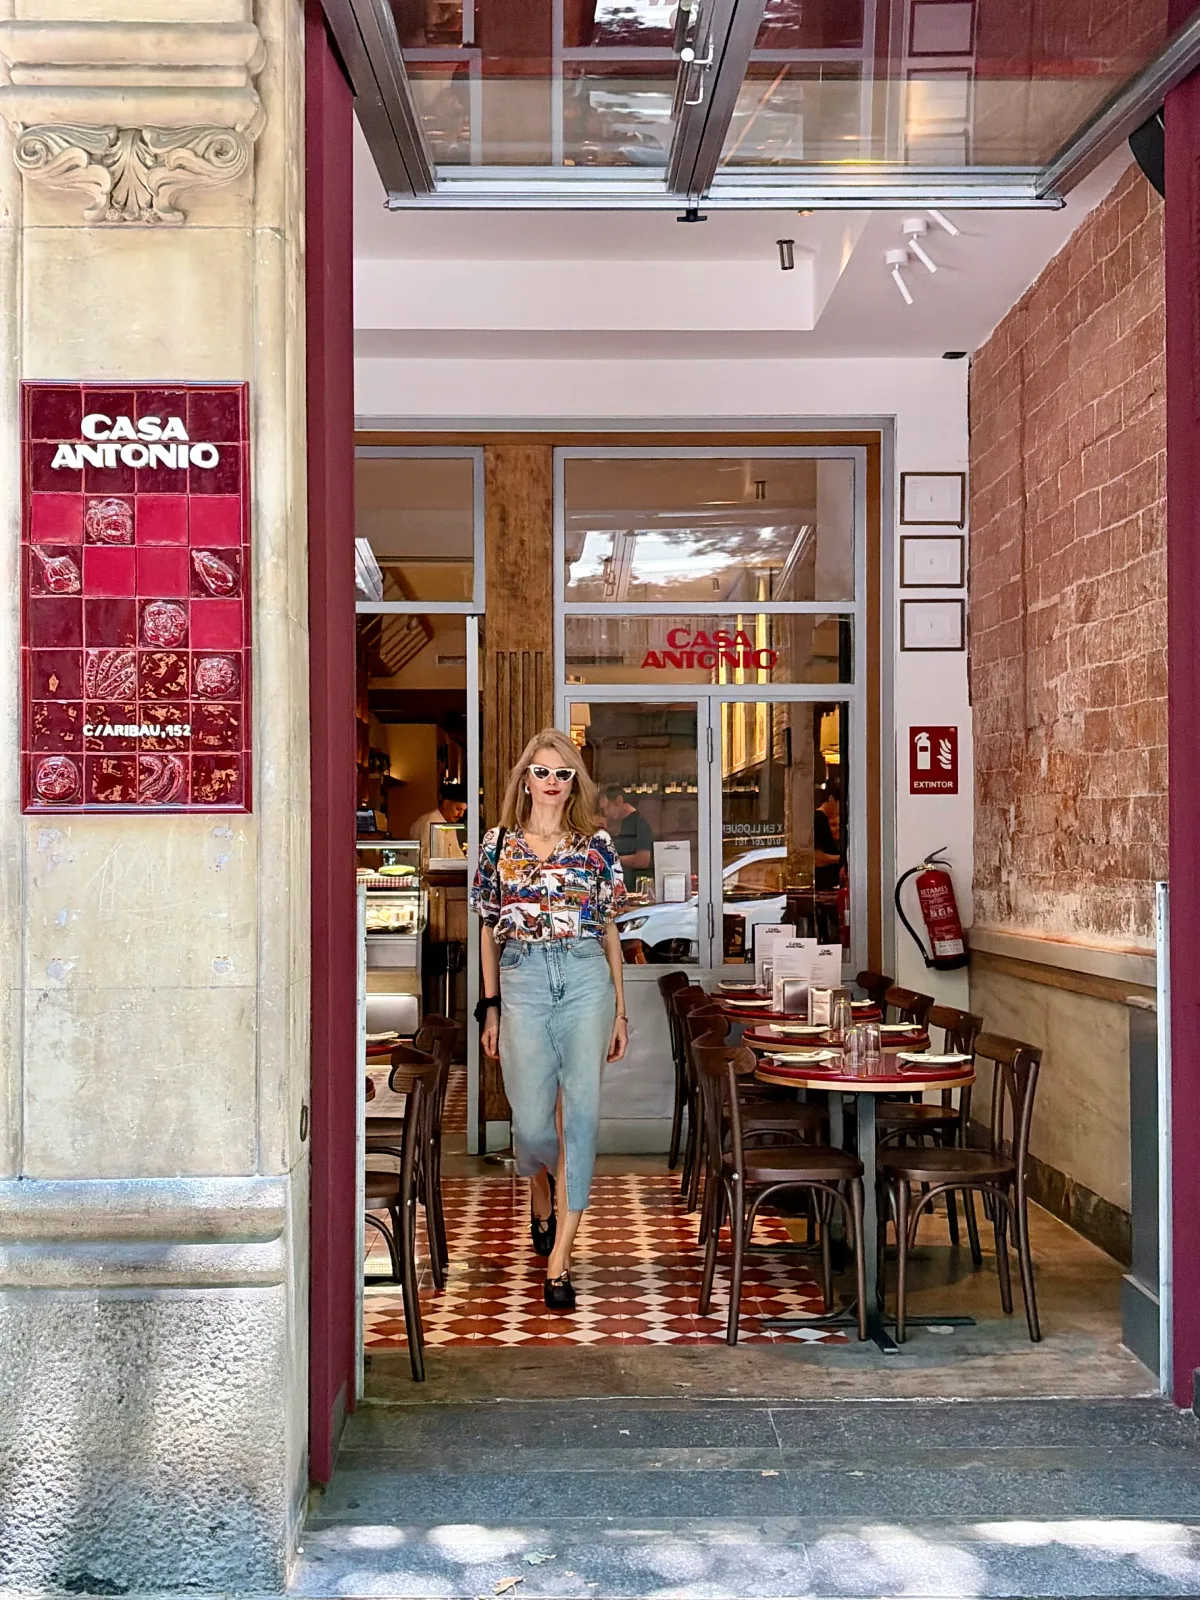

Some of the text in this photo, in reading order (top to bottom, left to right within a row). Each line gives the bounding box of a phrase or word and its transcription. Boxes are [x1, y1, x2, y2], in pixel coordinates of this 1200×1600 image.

[80, 413, 190, 441] CASA
[51, 443, 220, 469] ANTONIO
[667, 628, 752, 649] CASA
[641, 648, 777, 669] ANTONIO
[913, 781, 954, 789] EXTINTOR
